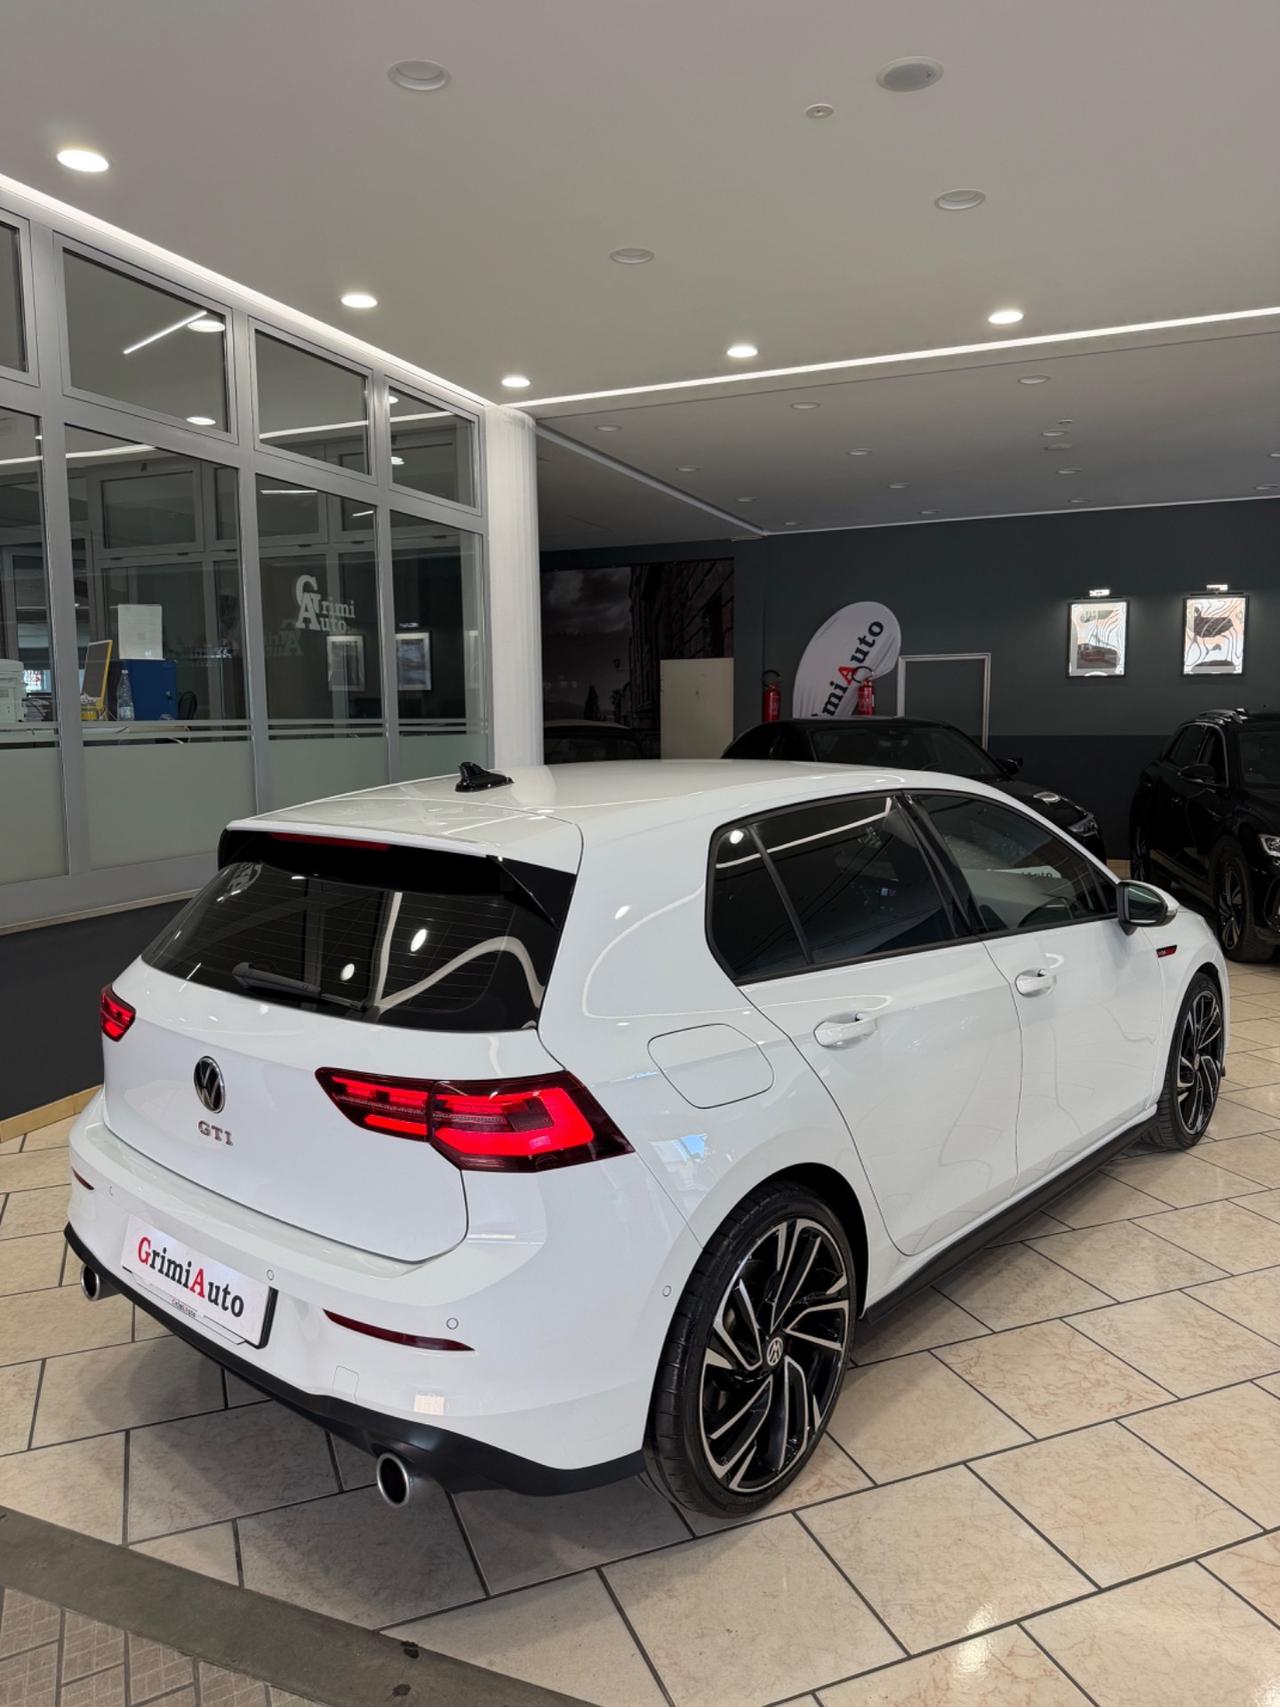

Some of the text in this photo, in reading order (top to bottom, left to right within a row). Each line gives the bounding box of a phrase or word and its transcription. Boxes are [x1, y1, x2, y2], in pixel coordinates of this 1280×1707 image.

[295, 592, 347, 632] Auto
[296, 574, 356, 618] Grimi
[811, 621, 884, 717] miAuto
[198, 1120, 234, 1146] GTI
[138, 1236, 244, 1318] GrimiAuto
